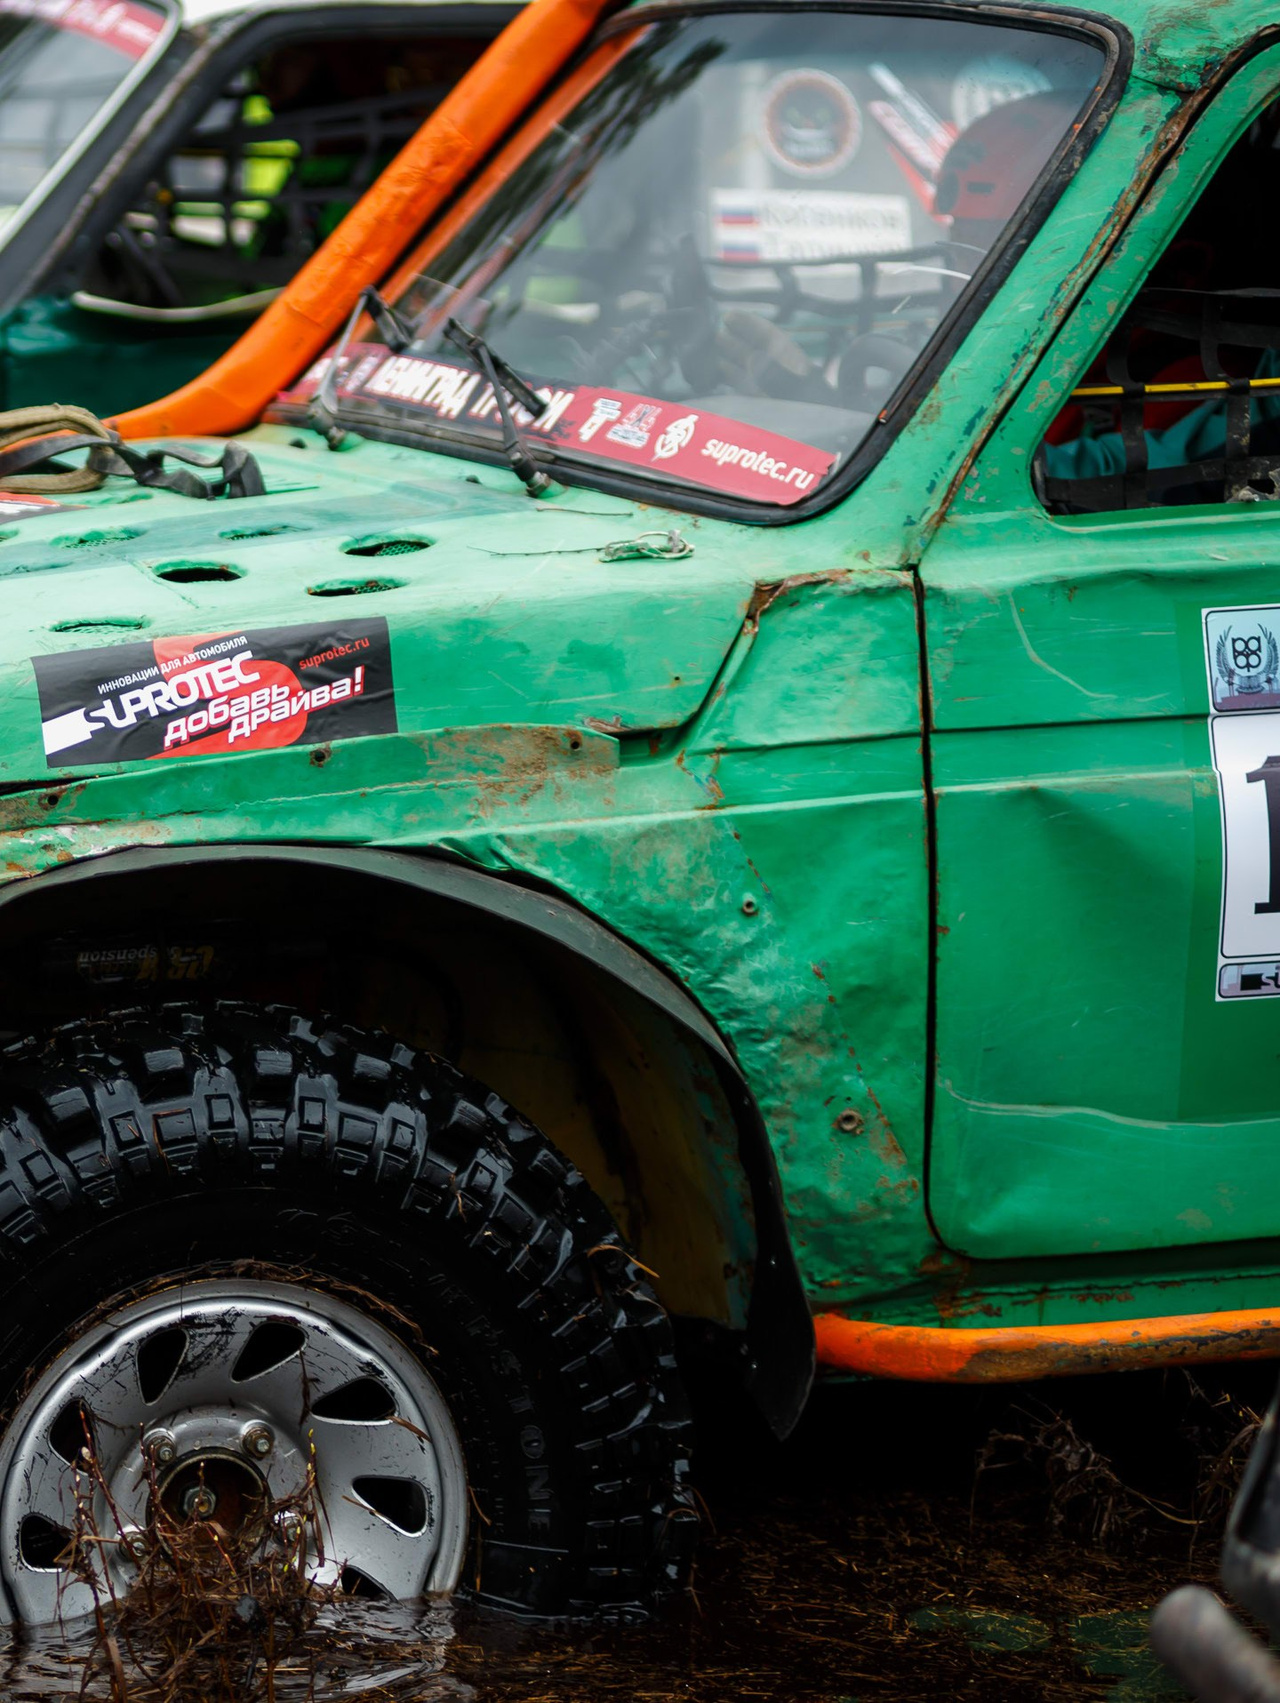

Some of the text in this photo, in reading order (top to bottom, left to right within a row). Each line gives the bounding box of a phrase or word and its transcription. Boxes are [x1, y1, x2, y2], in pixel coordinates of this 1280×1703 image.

[700, 437, 815, 490] suprotec.ru
[97, 635, 249, 695] ИННОВАЦИИ ДЛЯ АВТОМОБИЛЯ
[298, 637, 371, 671] suprotec.ru
